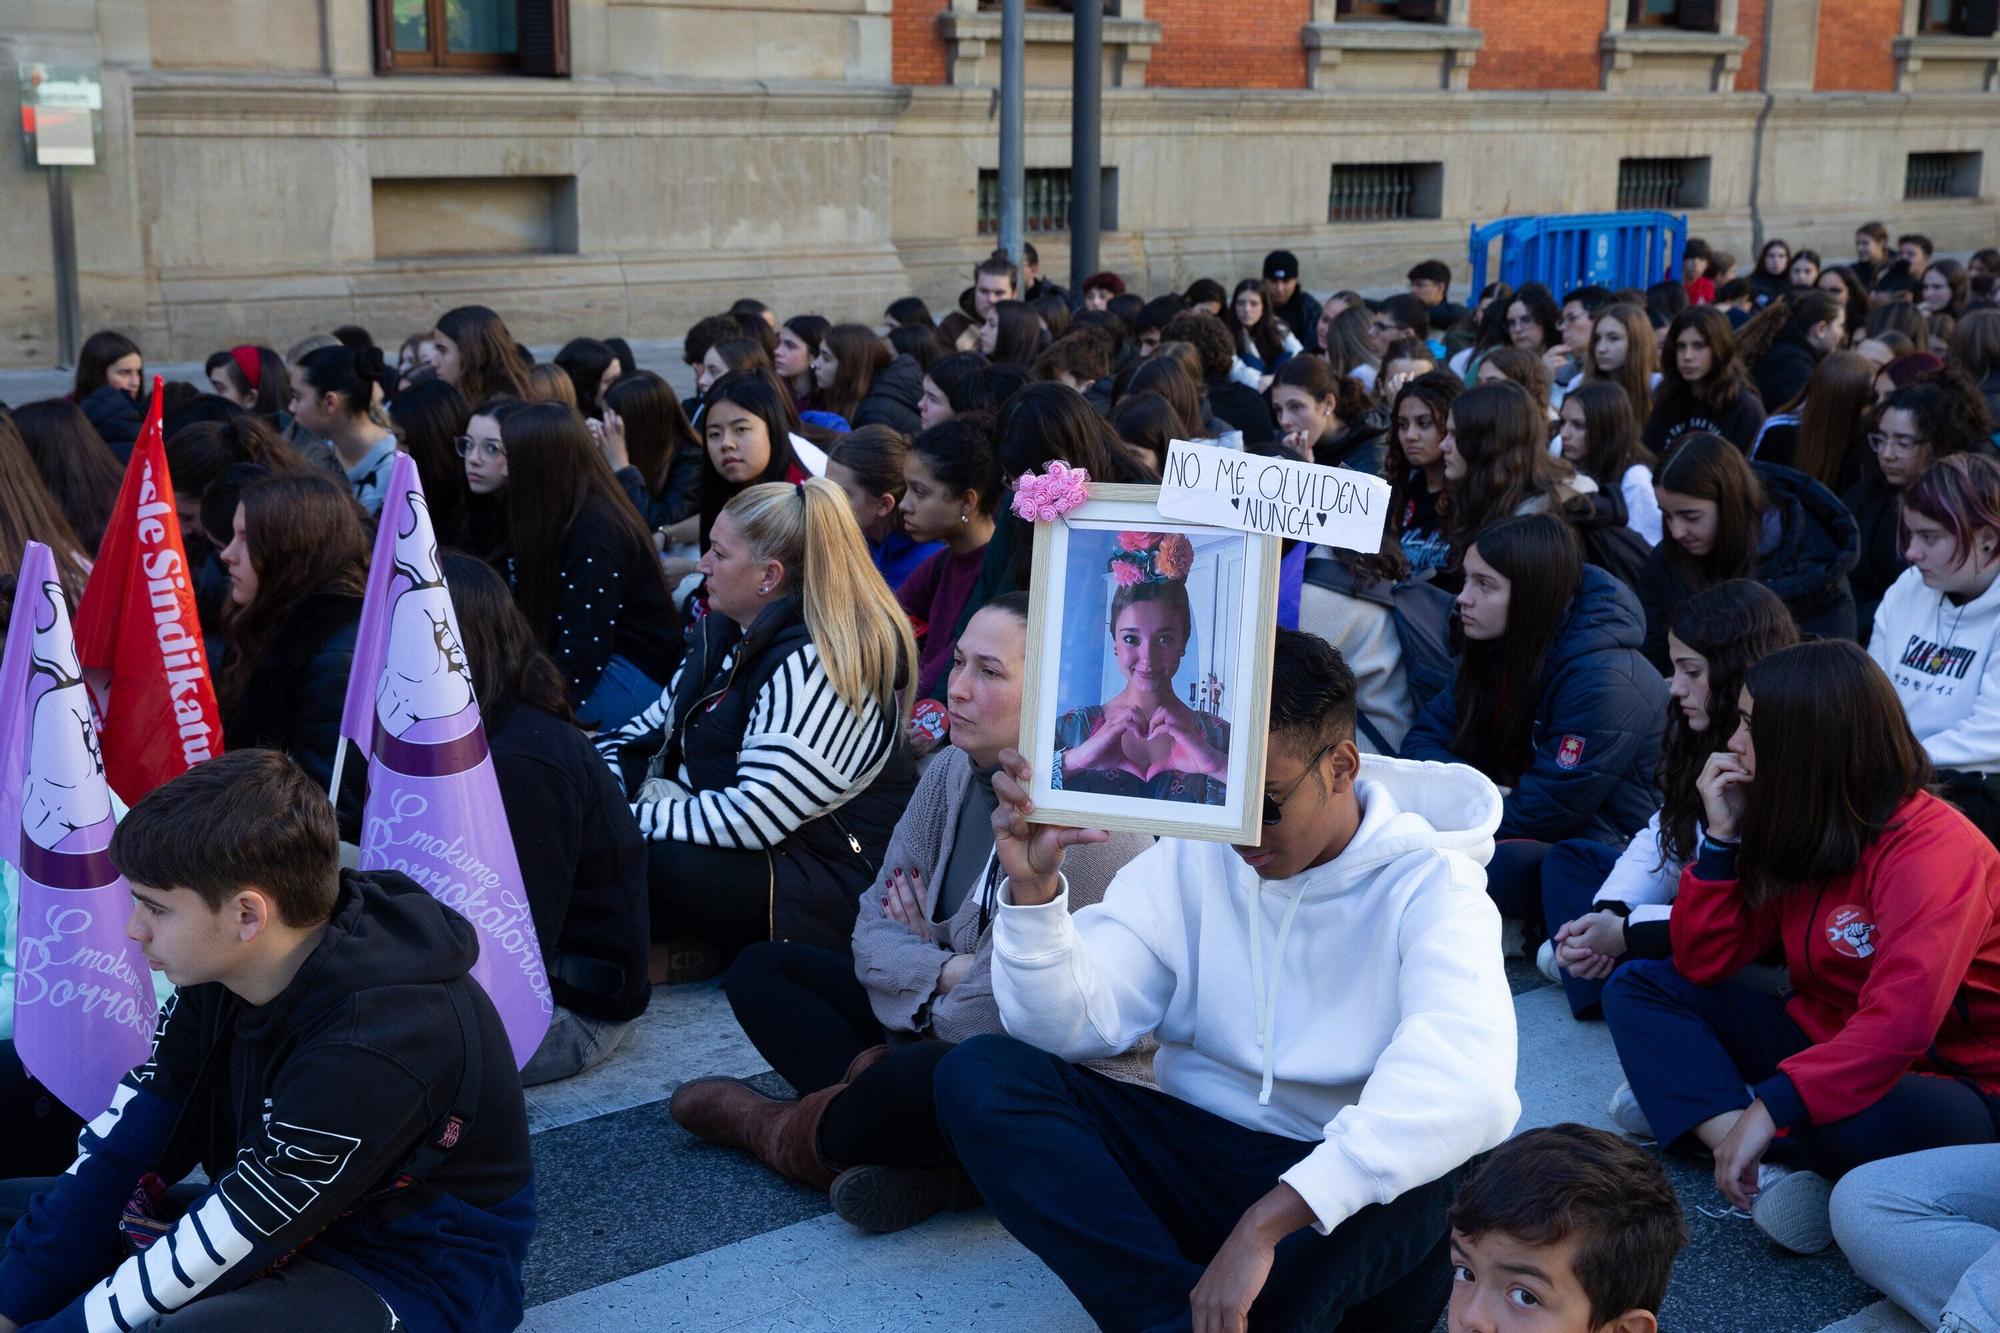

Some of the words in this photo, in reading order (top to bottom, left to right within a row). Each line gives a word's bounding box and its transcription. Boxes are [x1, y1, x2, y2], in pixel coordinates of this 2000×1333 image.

[1168, 451, 1201, 489] NO
[1214, 458, 1248, 496] ME
[1258, 464, 1370, 516] OLVIDEN
[1243, 497, 1314, 537] NUNCA
[143, 548, 212, 770] Sindikatu
[15, 935, 158, 1044] Borroka
